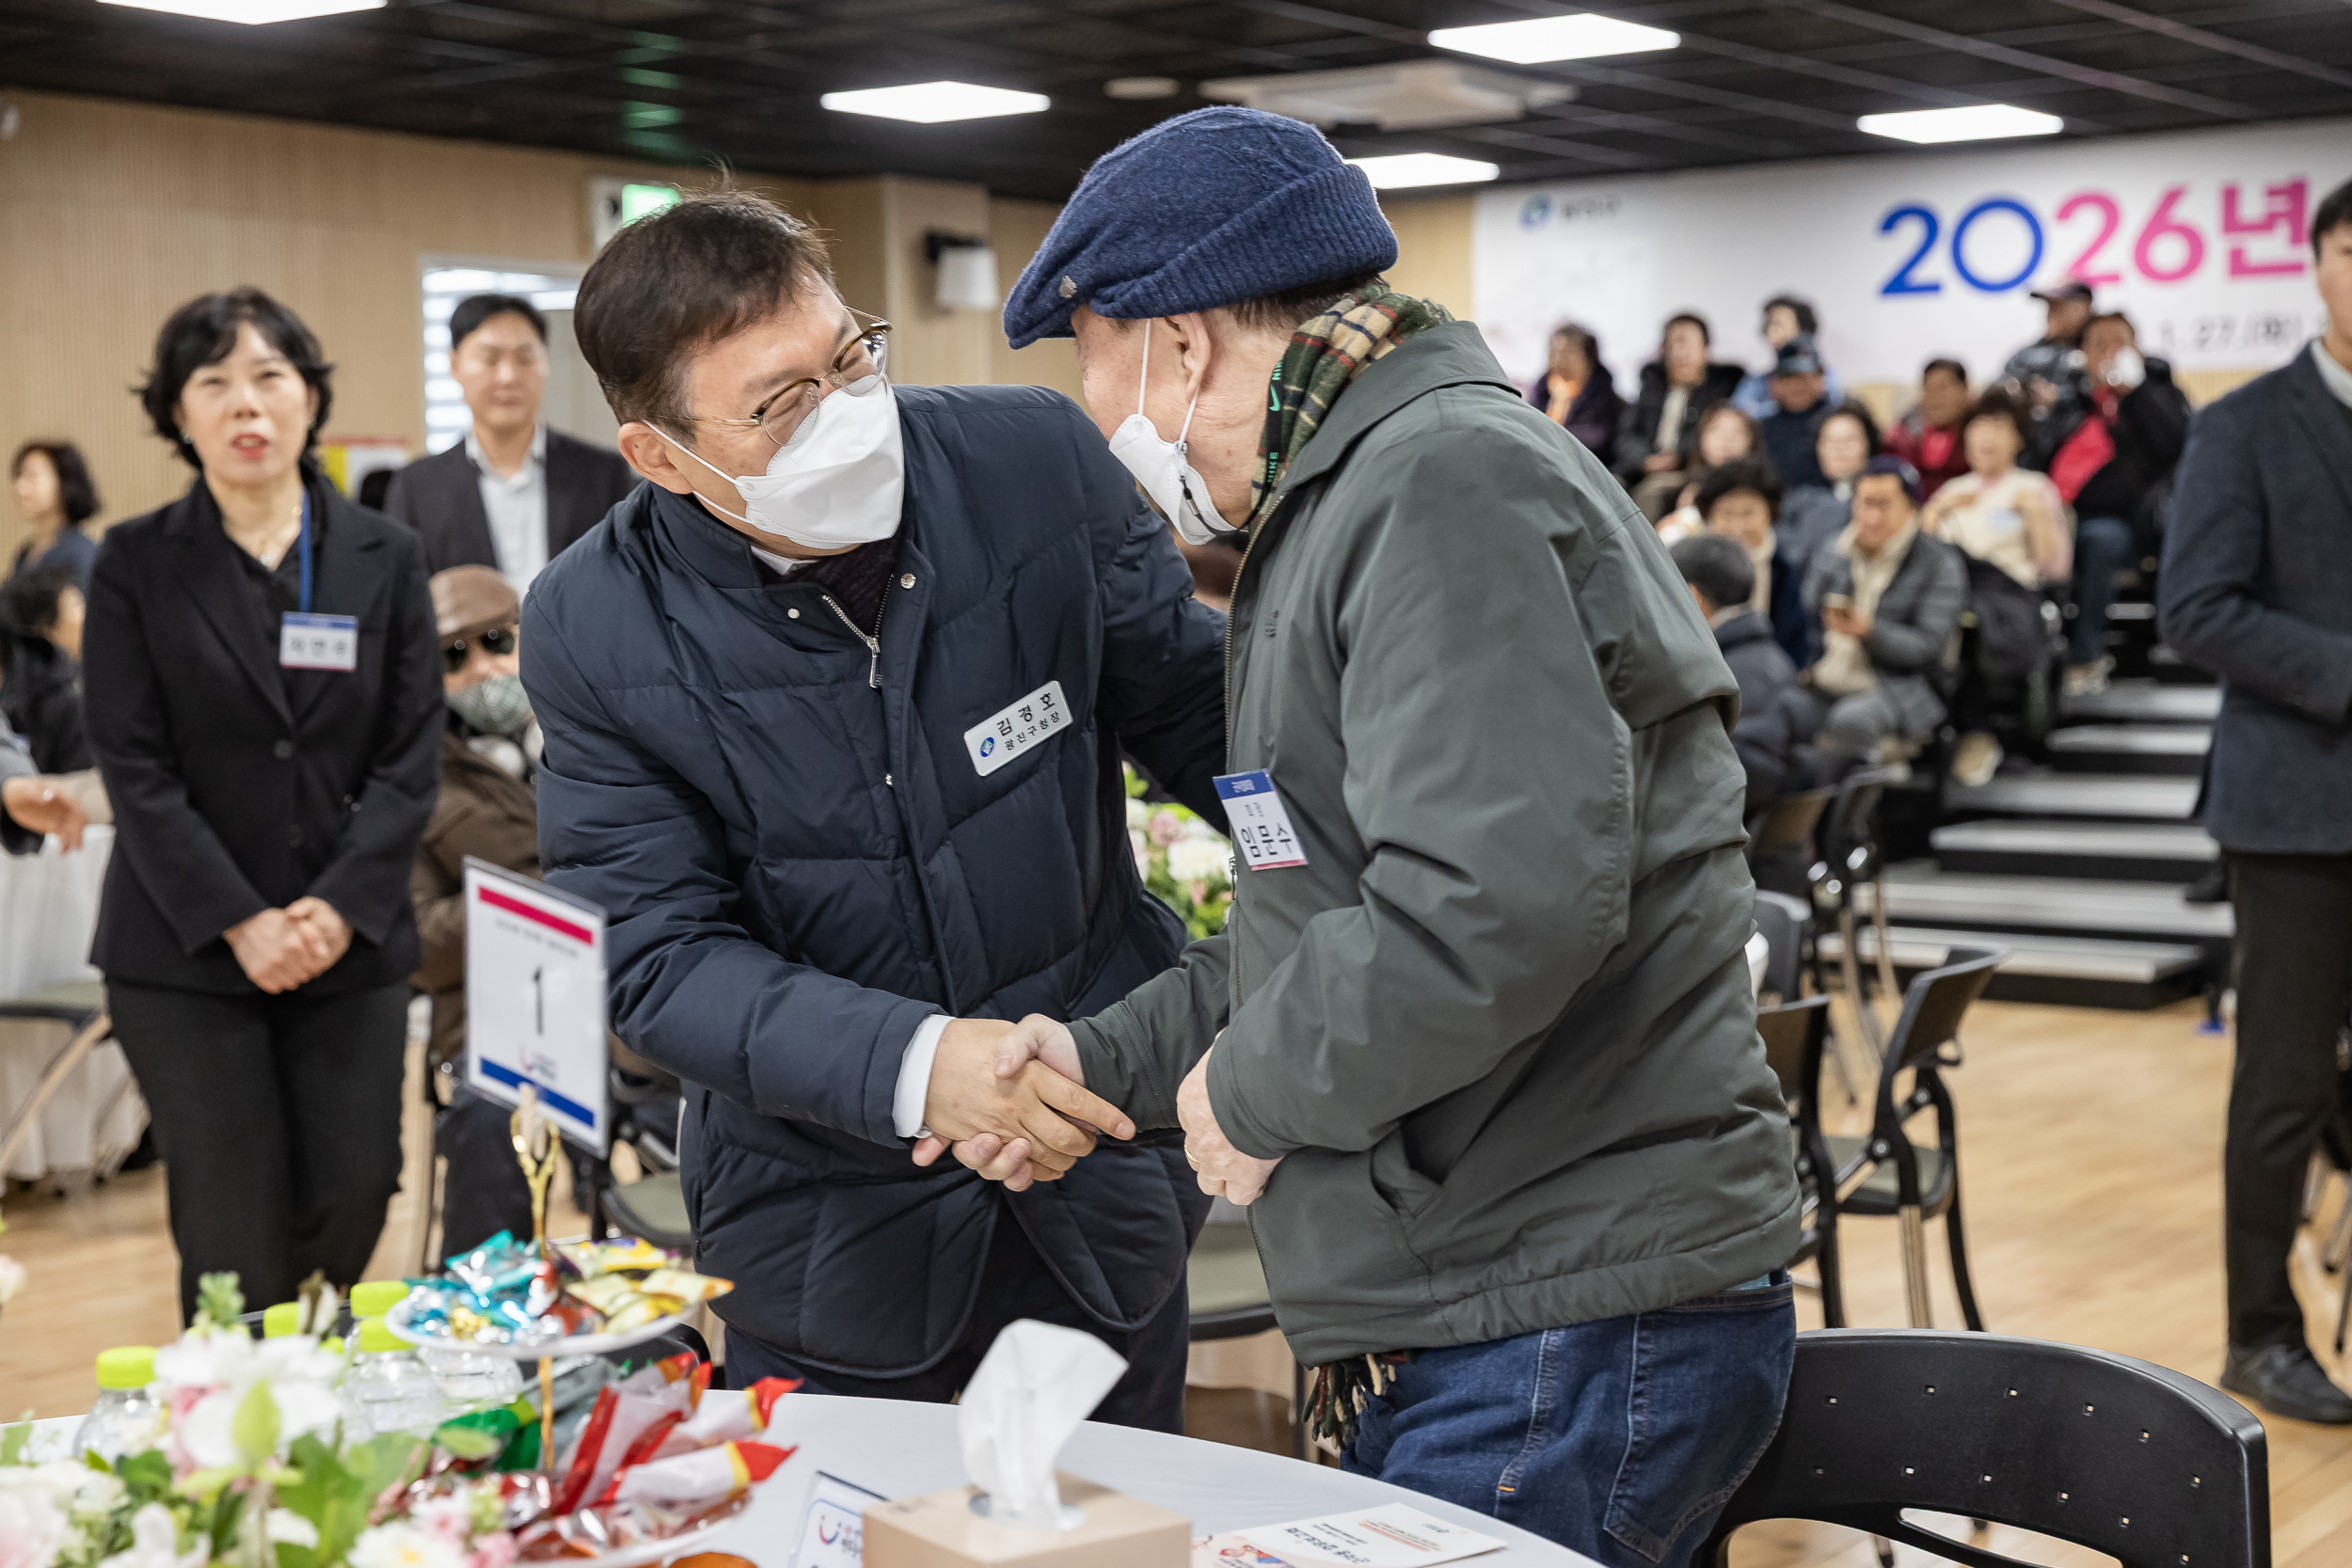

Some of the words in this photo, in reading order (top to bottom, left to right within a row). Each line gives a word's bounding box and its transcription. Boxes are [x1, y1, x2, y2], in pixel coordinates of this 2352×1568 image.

[1881, 176, 2306, 297] 2026년
[1267, 451, 1279, 483] NIKE
[996, 691, 1057, 737] 김경호
[1004, 711, 1060, 752] 광진구청장
[1240, 822, 1293, 857] 임문수
[532, 965, 545, 1037] 1
